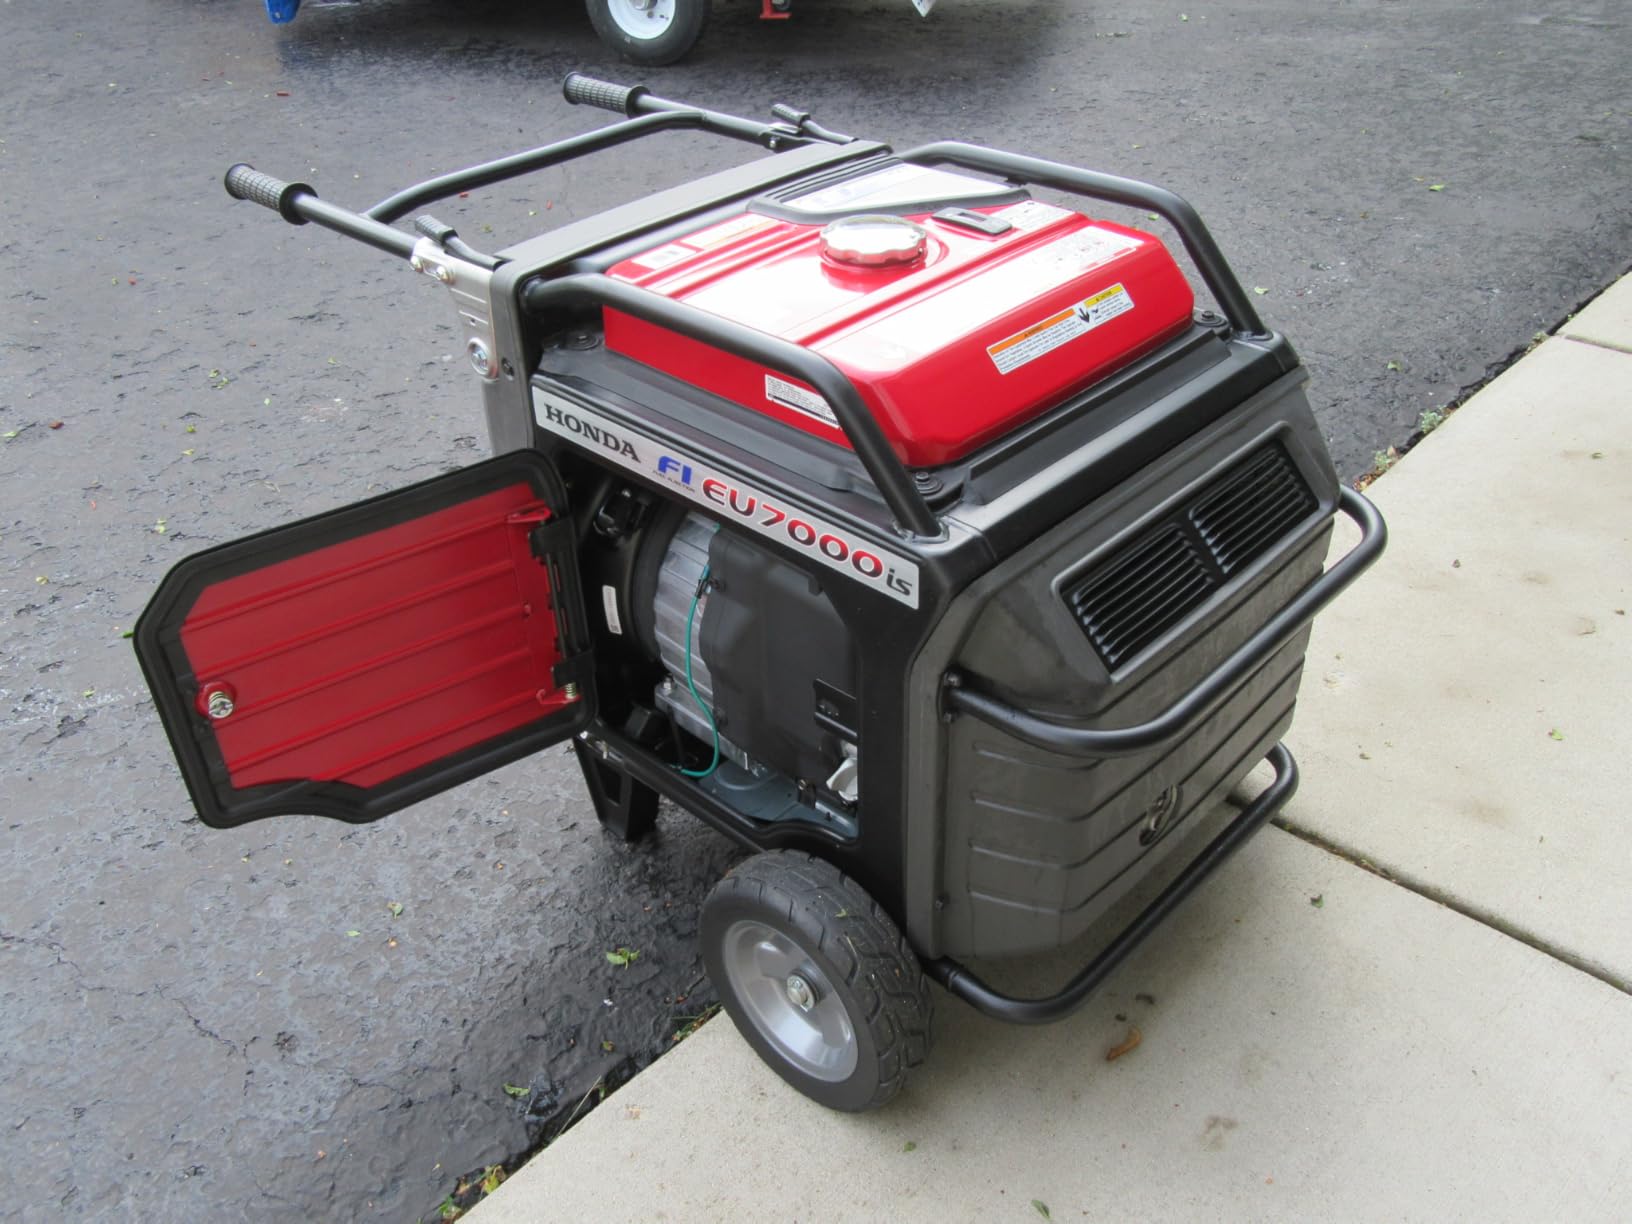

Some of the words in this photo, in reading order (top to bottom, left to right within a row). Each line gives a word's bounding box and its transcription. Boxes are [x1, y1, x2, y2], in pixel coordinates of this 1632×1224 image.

[544, 403, 641, 464] HONDA
[657, 455, 692, 485] FI
[702, 478, 913, 596] EU7000is
